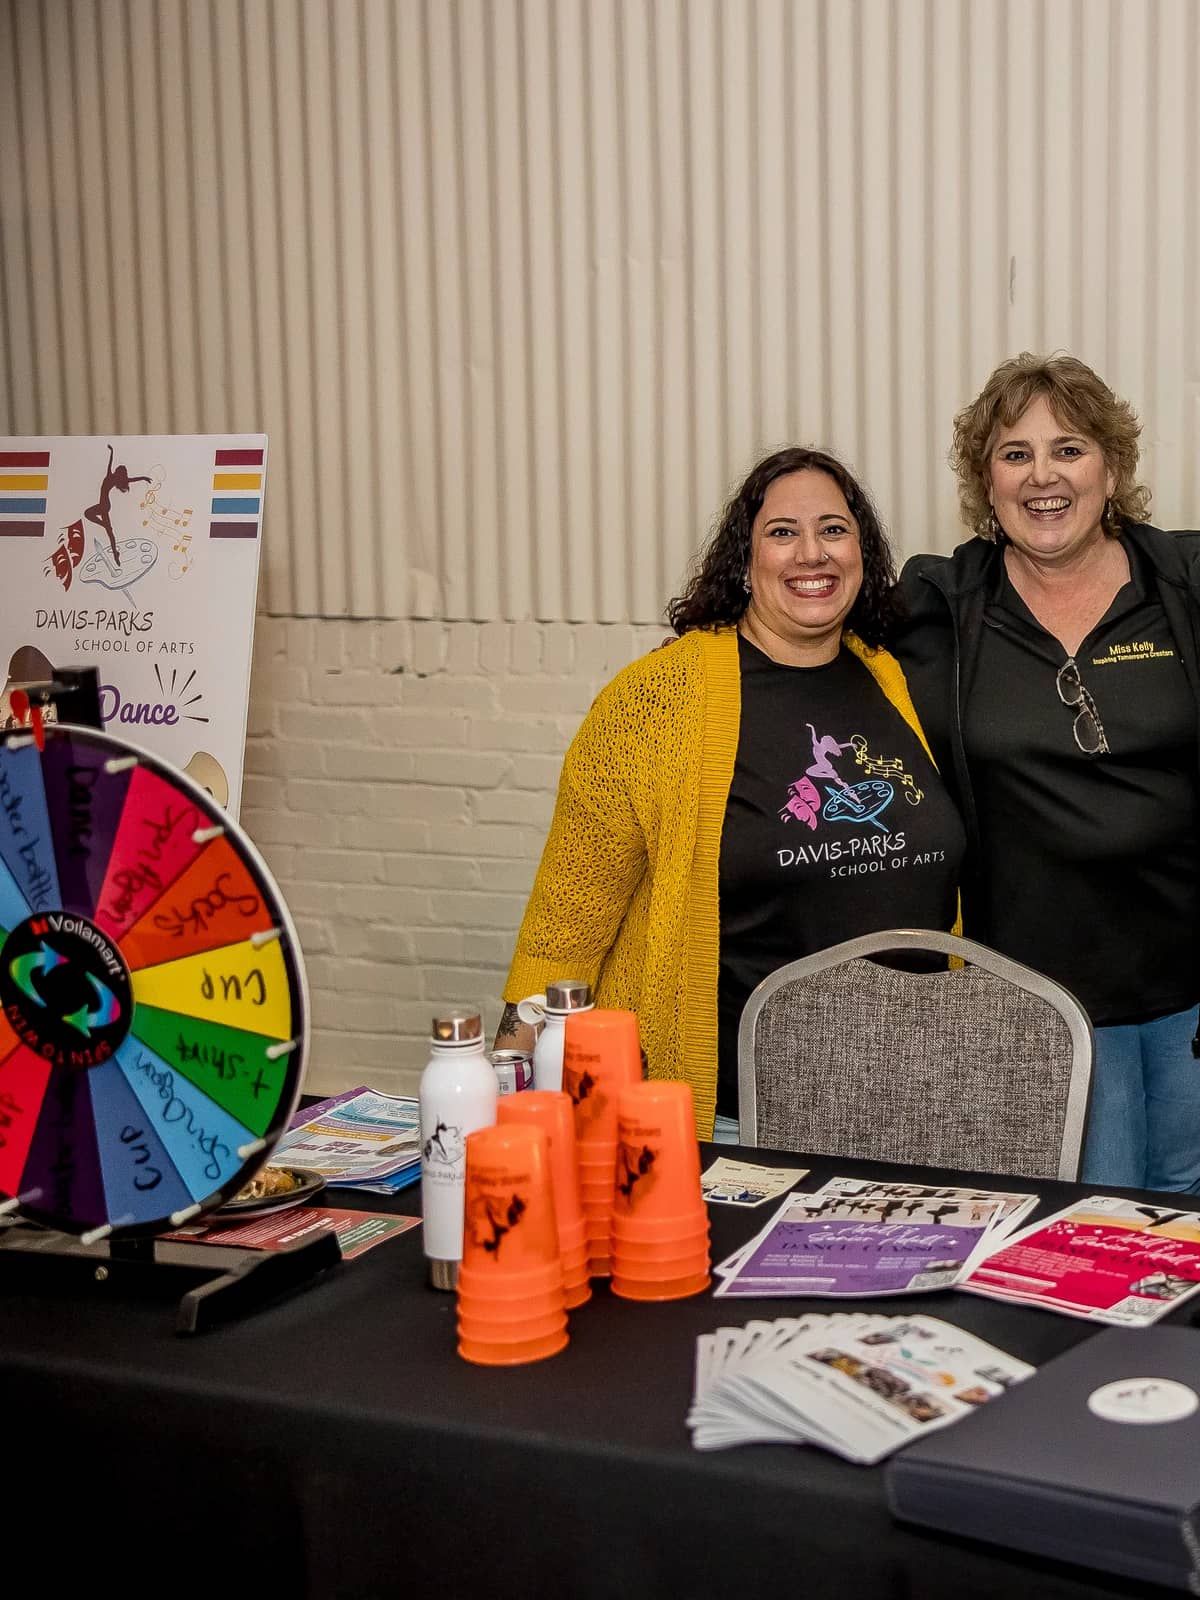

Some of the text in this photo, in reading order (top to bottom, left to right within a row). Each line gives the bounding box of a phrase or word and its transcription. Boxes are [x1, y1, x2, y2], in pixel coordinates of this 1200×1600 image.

[35, 608, 154, 636] DAVIS-PARKS
[73, 638, 195, 654] SCHOOL OF ARTS
[1092, 649, 1174, 665] Inspiring Tomorrow's Creators
[1109, 641, 1155, 656] Miss Kelly
[99, 684, 181, 726] Dance
[776, 831, 906, 868] DAVIS-PARKS
[829, 850, 946, 879] SCHOOL OF ARTS
[48, 914, 123, 976] Voilamart
